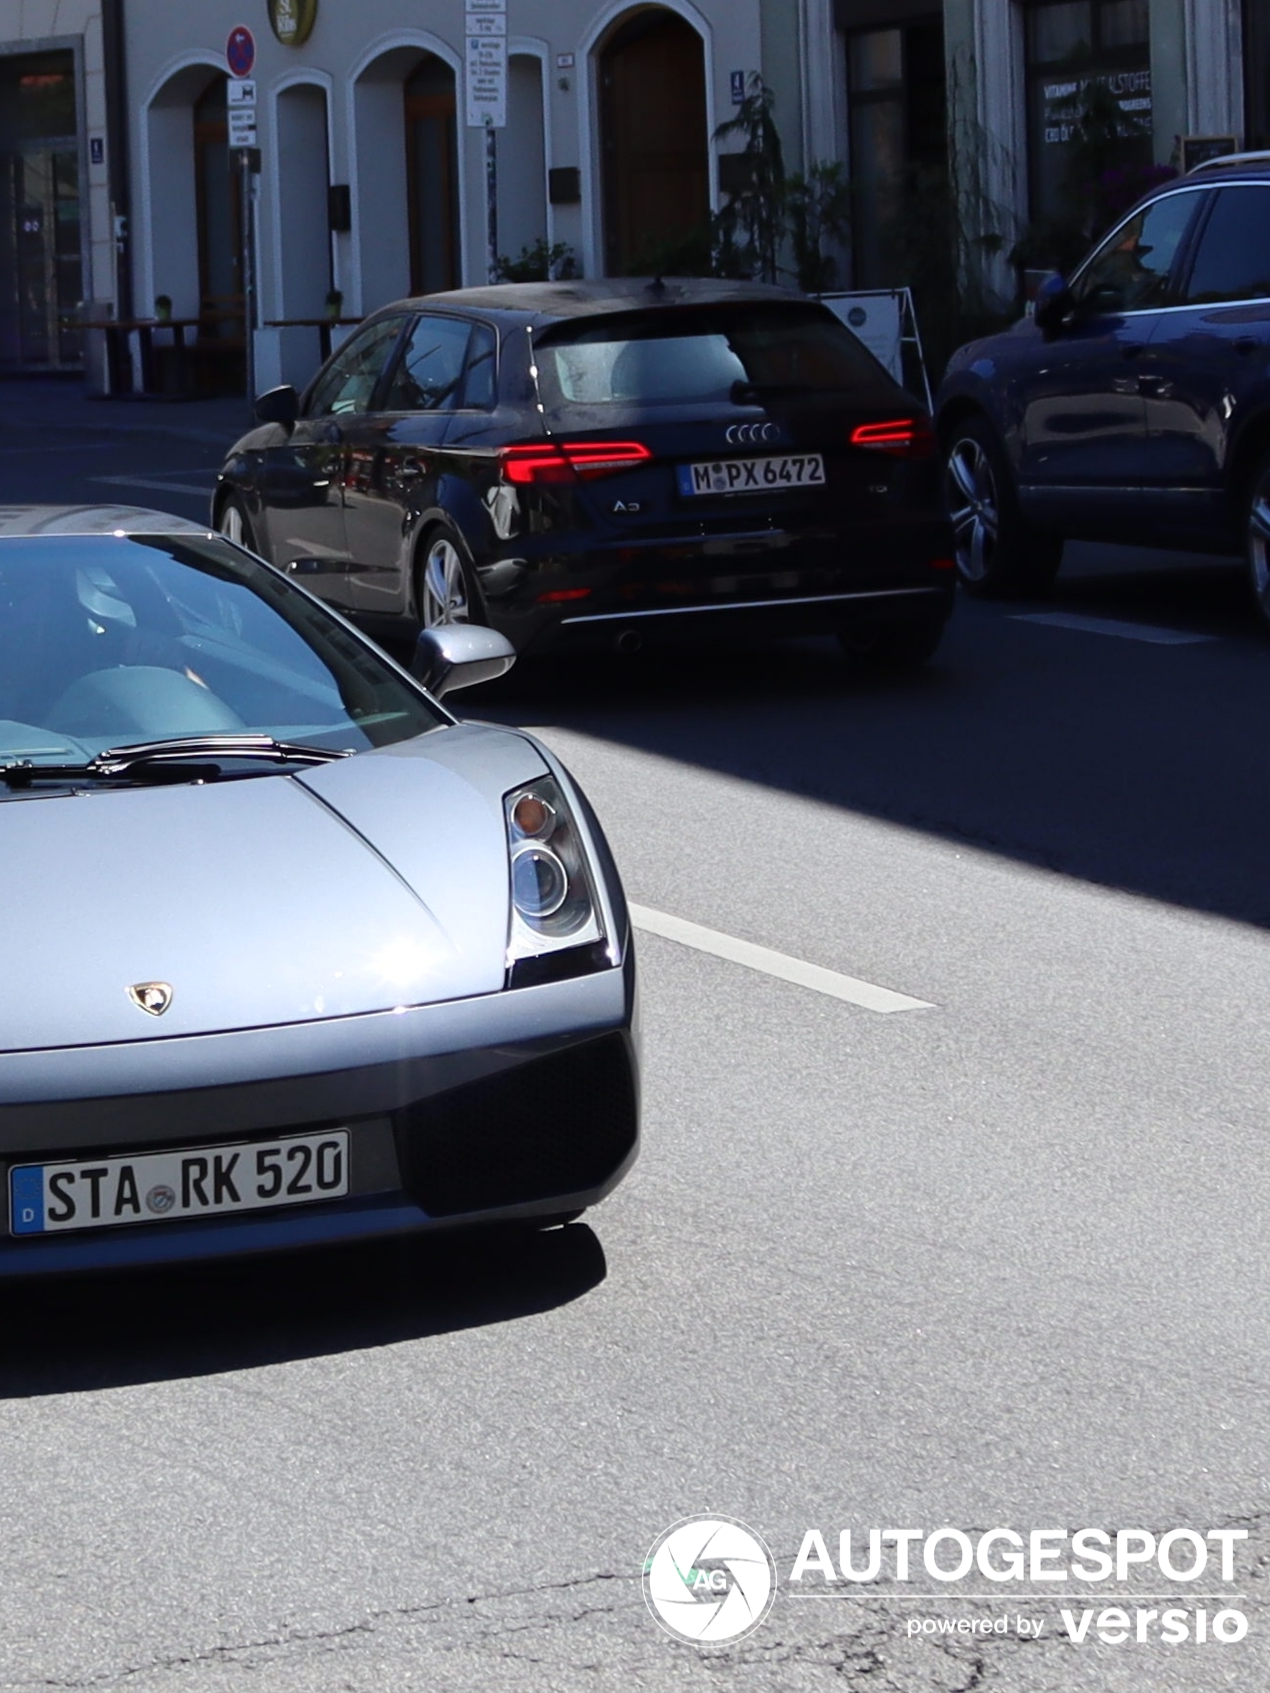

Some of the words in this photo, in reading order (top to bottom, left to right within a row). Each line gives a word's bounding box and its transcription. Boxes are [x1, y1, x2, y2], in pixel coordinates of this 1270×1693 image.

[694, 468, 711, 491] M
[727, 462, 759, 488] PX
[764, 457, 823, 485] 6472
[613, 500, 640, 512] A3
[23, 1209, 34, 1222] D
[48, 1166, 141, 1223] STA
[182, 1153, 241, 1209] RK
[256, 1141, 343, 1199] 520
